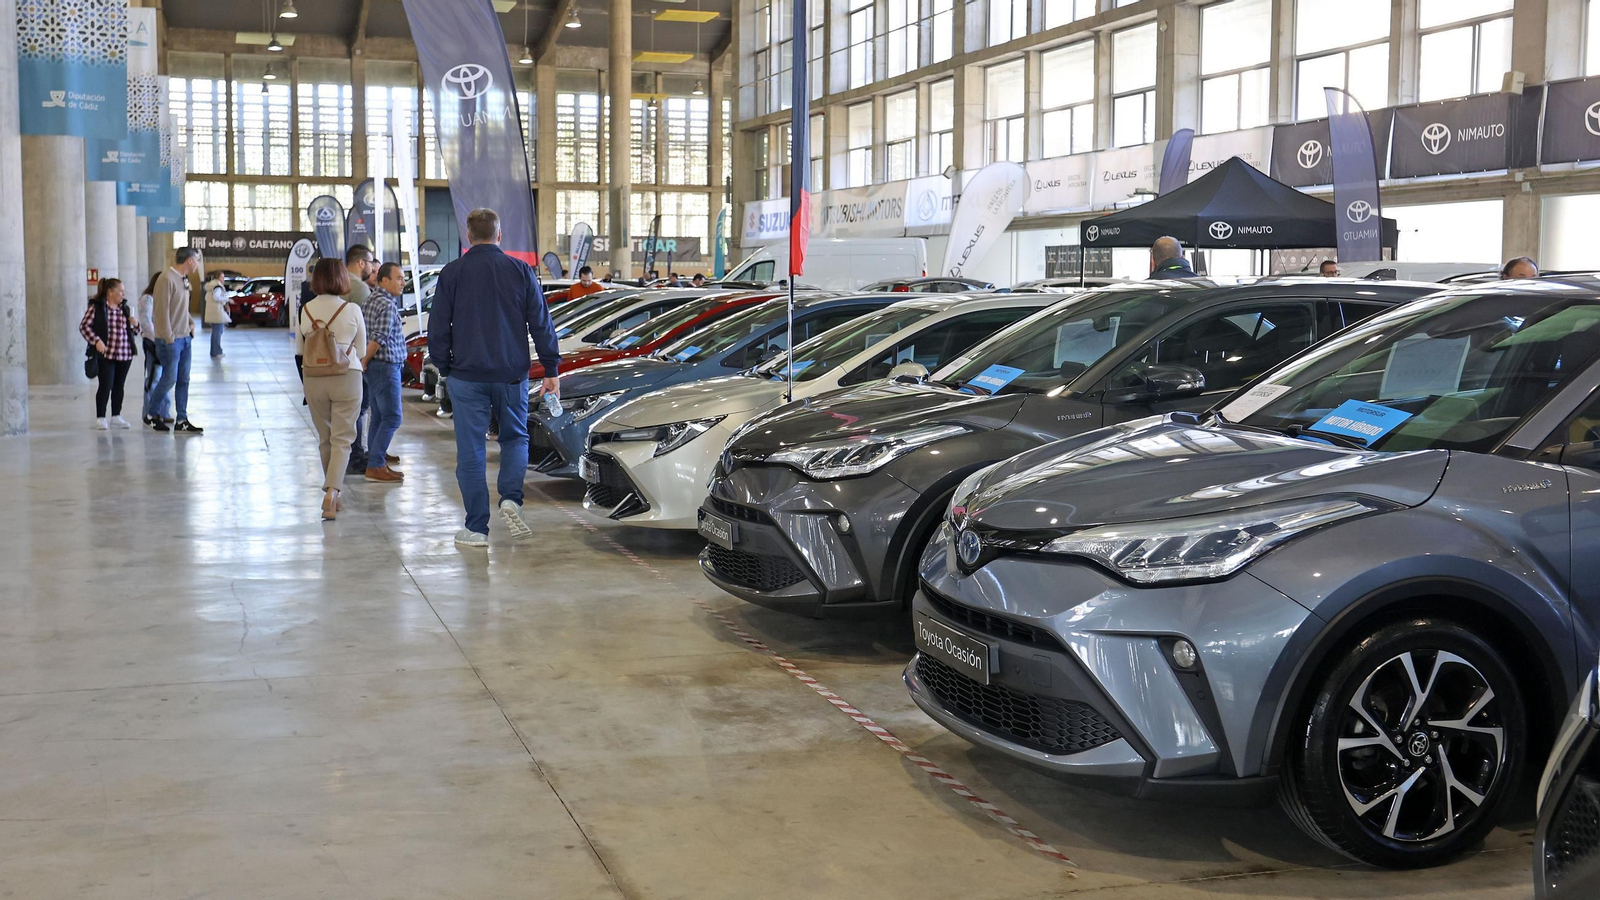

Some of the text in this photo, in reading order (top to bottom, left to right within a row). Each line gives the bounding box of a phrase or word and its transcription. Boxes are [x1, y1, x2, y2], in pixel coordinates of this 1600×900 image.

[69, 91, 105, 102] Diputación
[79, 101, 99, 110] Cádiz
[1458, 123, 1505, 142] NIMAUTO
[758, 212, 791, 233] SUZUK
[1100, 227, 1120, 237] NIMAUTO
[1237, 225, 1273, 235] NIMAUTO
[191, 237, 231, 250] FIAT Jeep
[249, 240, 293, 250] CAETANO
[957, 224, 985, 267] LEXUS
[420, 248, 437, 257] Jeep
[1323, 415, 1383, 437] MOTOR HÍBRIDO
[711, 522, 729, 541] Ocasión
[918, 621, 982, 670] Toyota Ocasión
